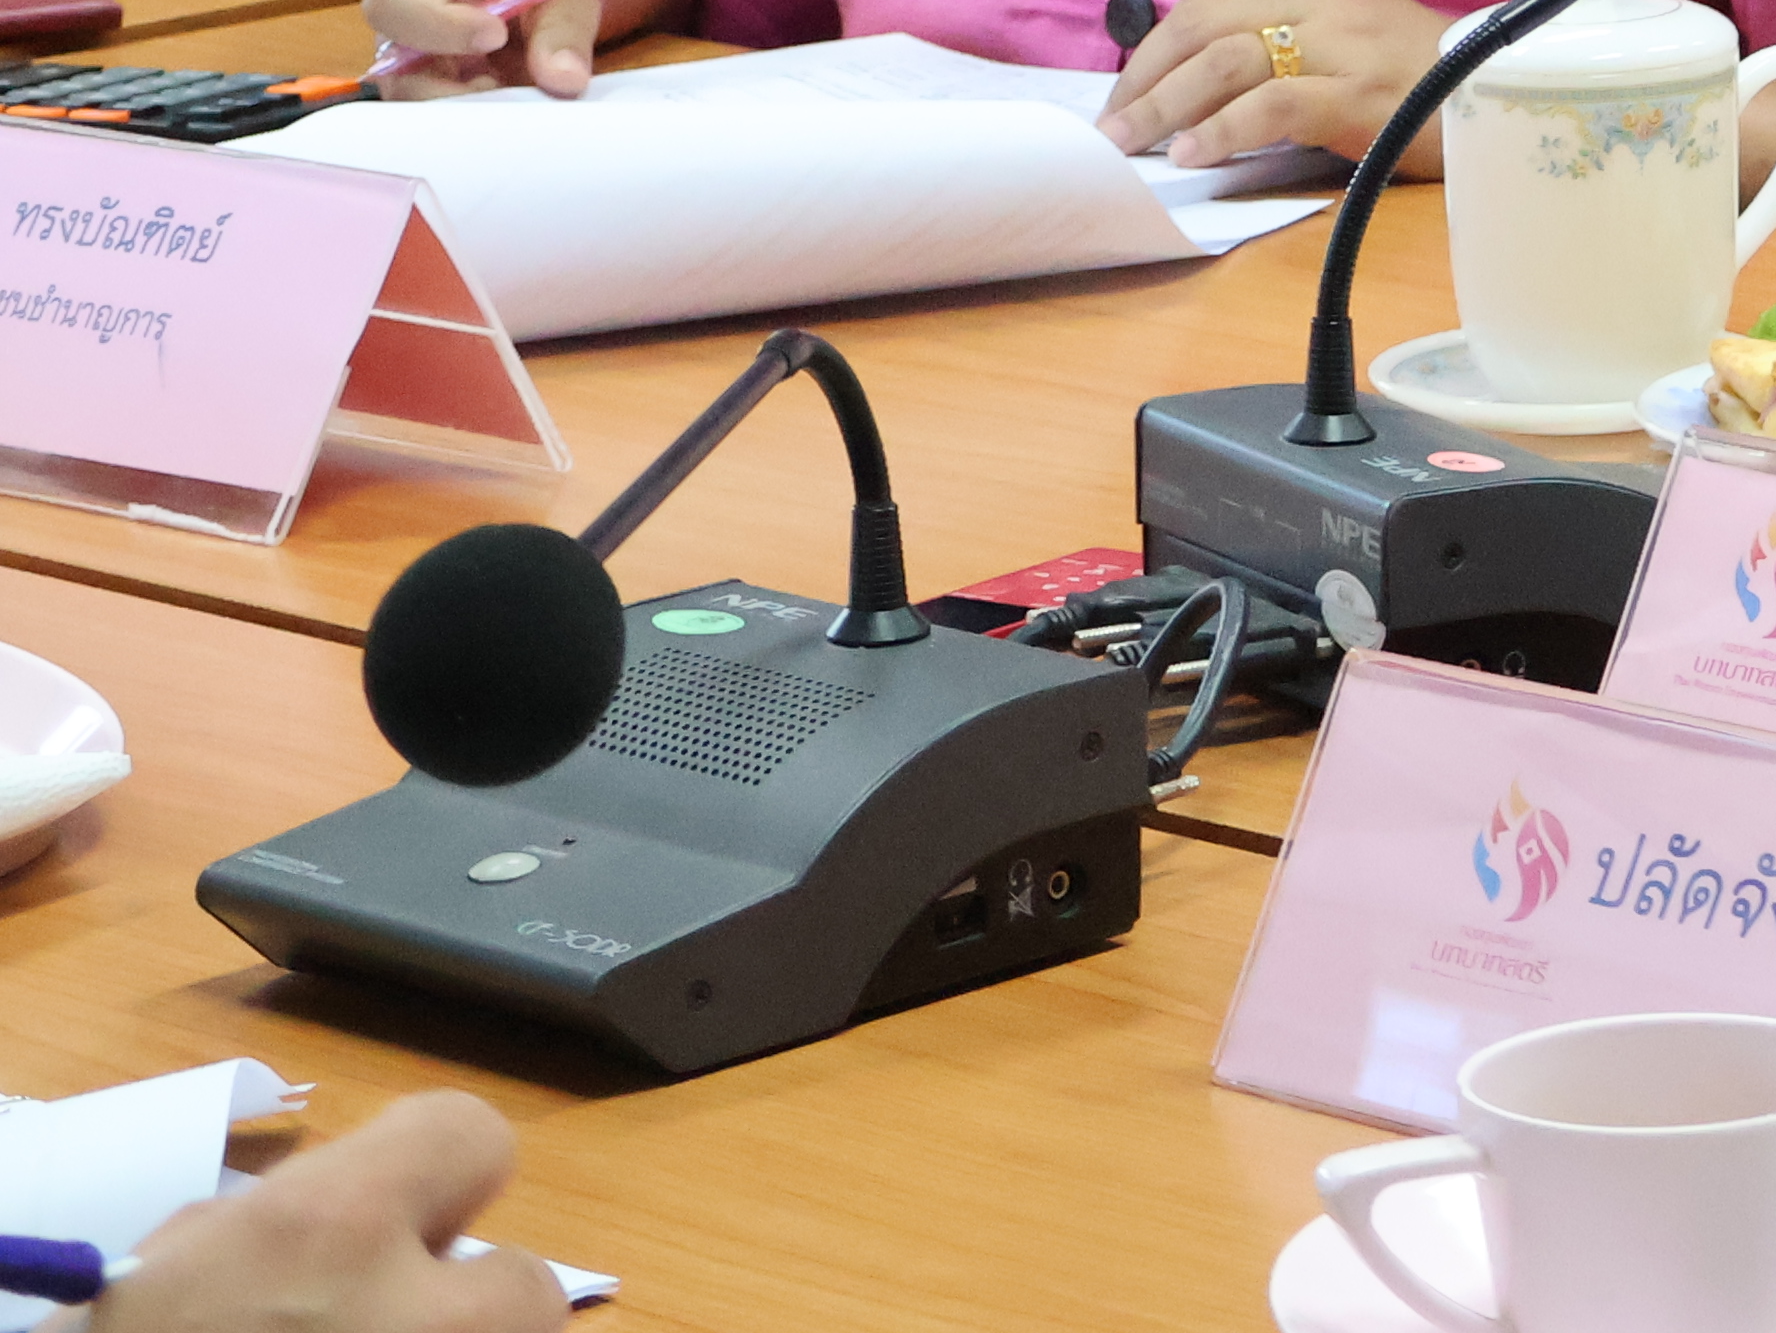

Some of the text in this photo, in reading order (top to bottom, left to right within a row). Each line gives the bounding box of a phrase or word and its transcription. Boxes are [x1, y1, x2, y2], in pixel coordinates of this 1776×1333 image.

[13, 196, 233, 263] ทรงบัณฑิตย์
[1320, 508, 1382, 561] NPE
